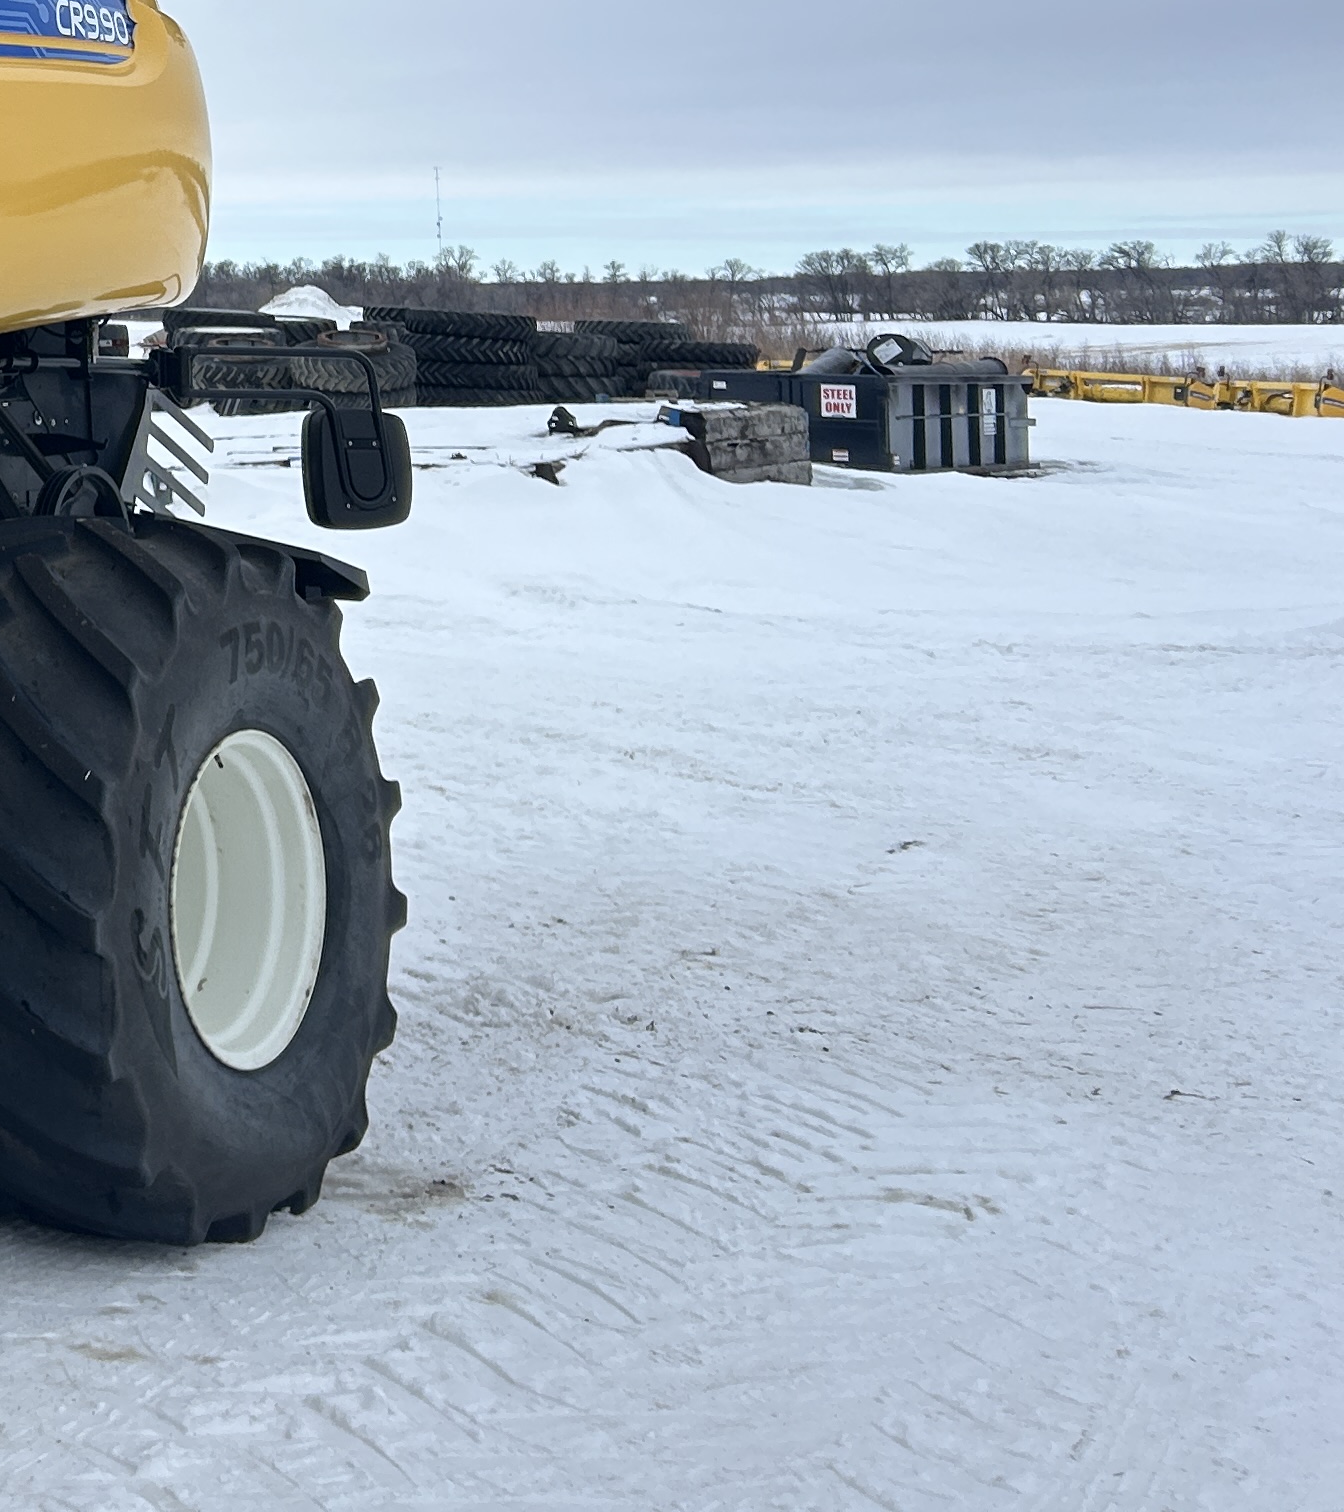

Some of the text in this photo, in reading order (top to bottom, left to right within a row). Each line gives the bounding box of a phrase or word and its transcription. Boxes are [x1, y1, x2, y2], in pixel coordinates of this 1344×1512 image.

[823, 388, 854, 400] STEEL
[825, 401, 852, 414] ONLY
[220, 621, 335, 702] 750/65
